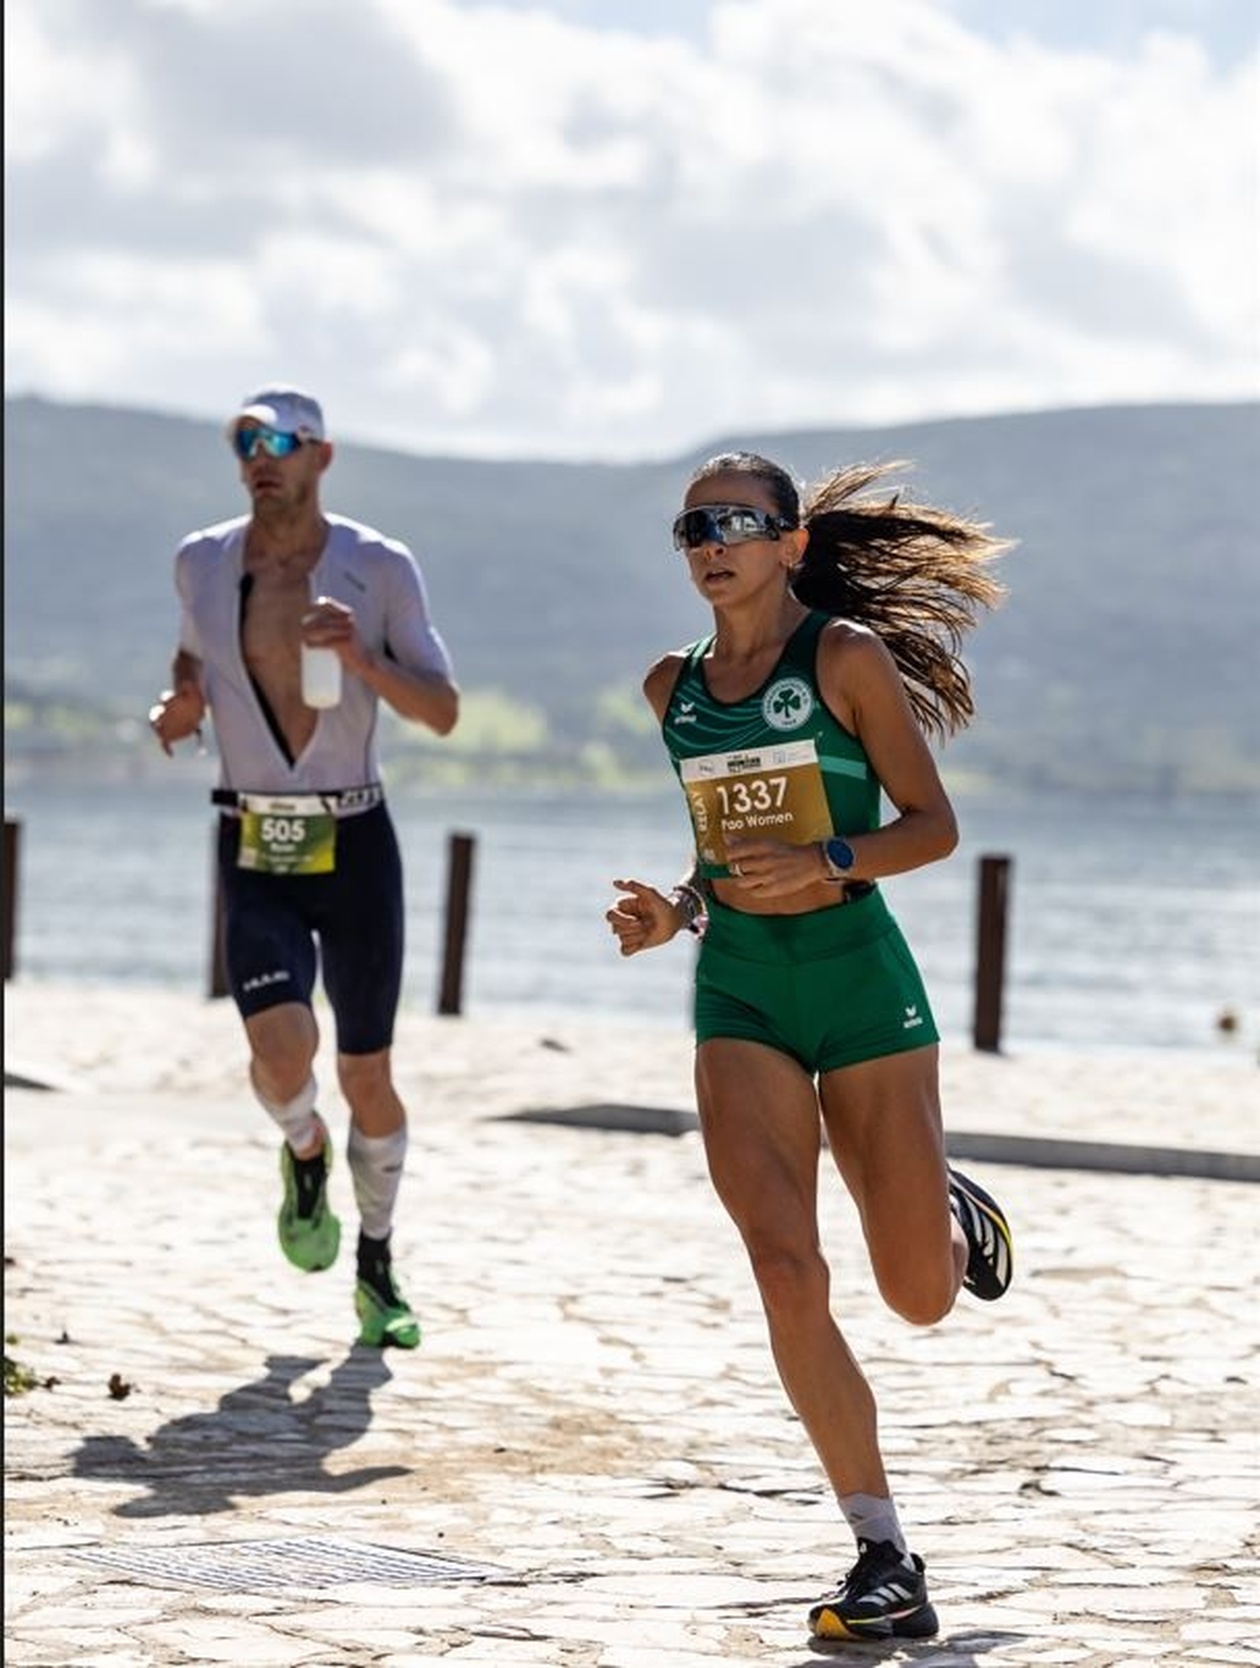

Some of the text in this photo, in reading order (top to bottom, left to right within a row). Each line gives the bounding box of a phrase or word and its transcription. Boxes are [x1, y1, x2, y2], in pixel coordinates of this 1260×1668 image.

[716, 776, 787, 815] 1337
[261, 817, 305, 842] 505
[746, 812, 793, 827] Women
